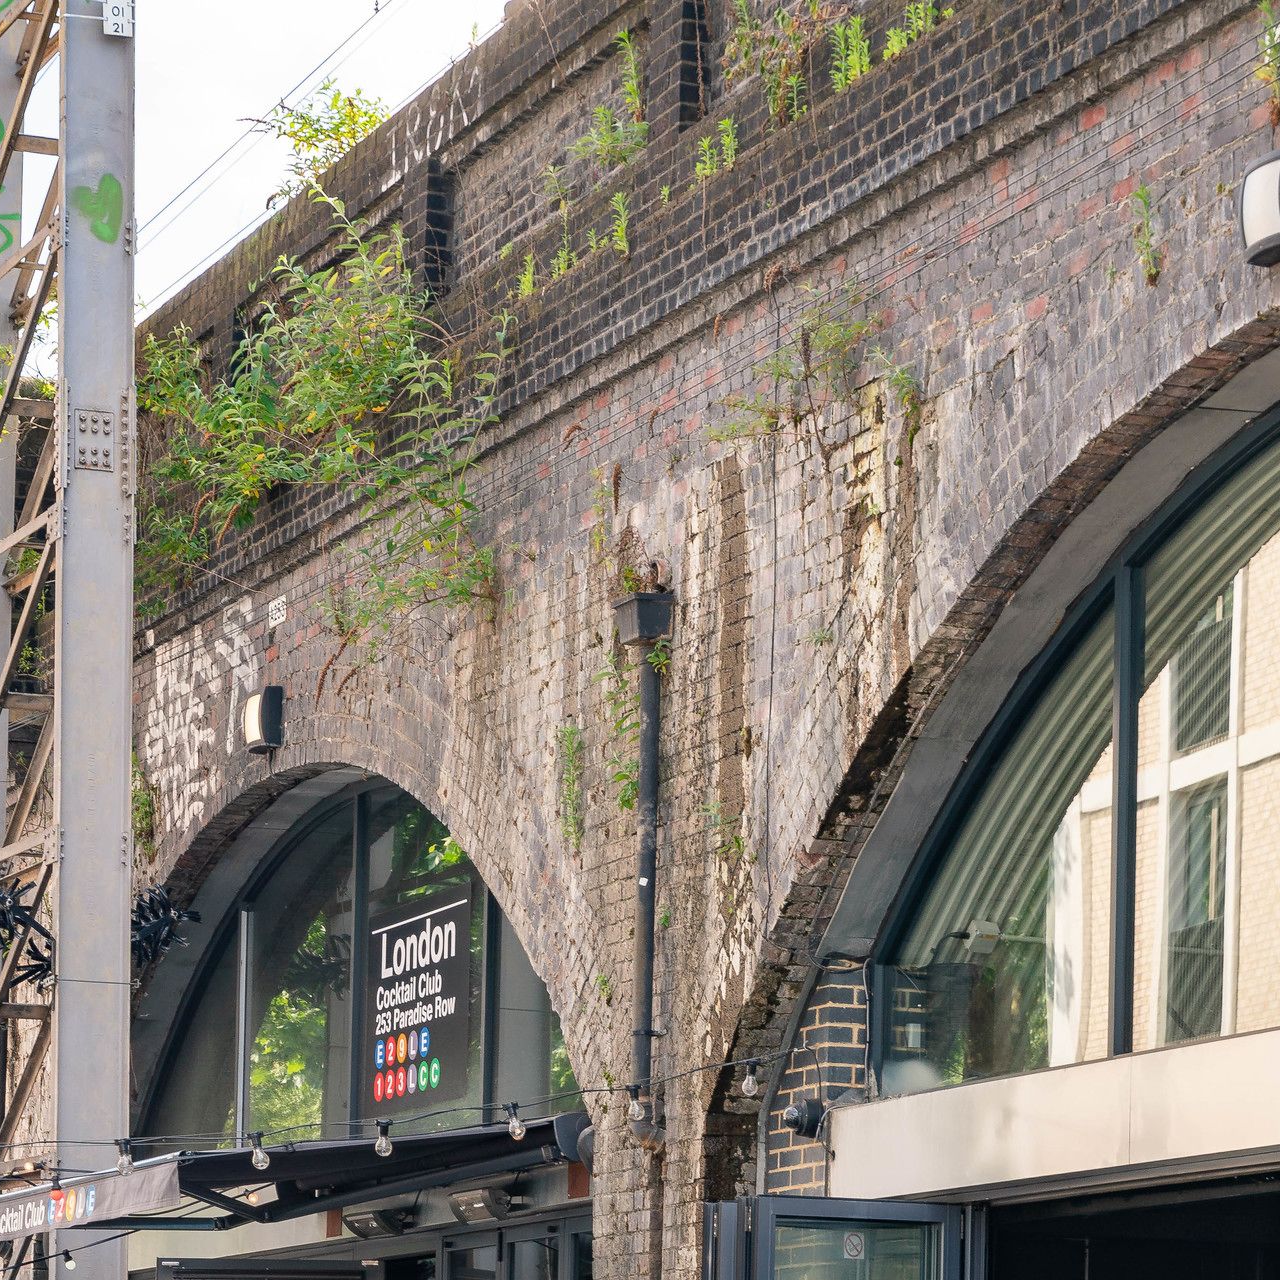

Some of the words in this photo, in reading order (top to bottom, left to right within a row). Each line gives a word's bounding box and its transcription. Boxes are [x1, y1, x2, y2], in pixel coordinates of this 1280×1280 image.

[112, 22, 124, 34] 21
[381, 918, 456, 980] London
[376, 975, 416, 1011] Cocktail
[418, 969, 443, 998] Club
[375, 1011, 392, 1036] 253
[393, 1000, 433, 1031] Paradise
[435, 996, 456, 1019] Row
[24, 1200, 46, 1229] Club
